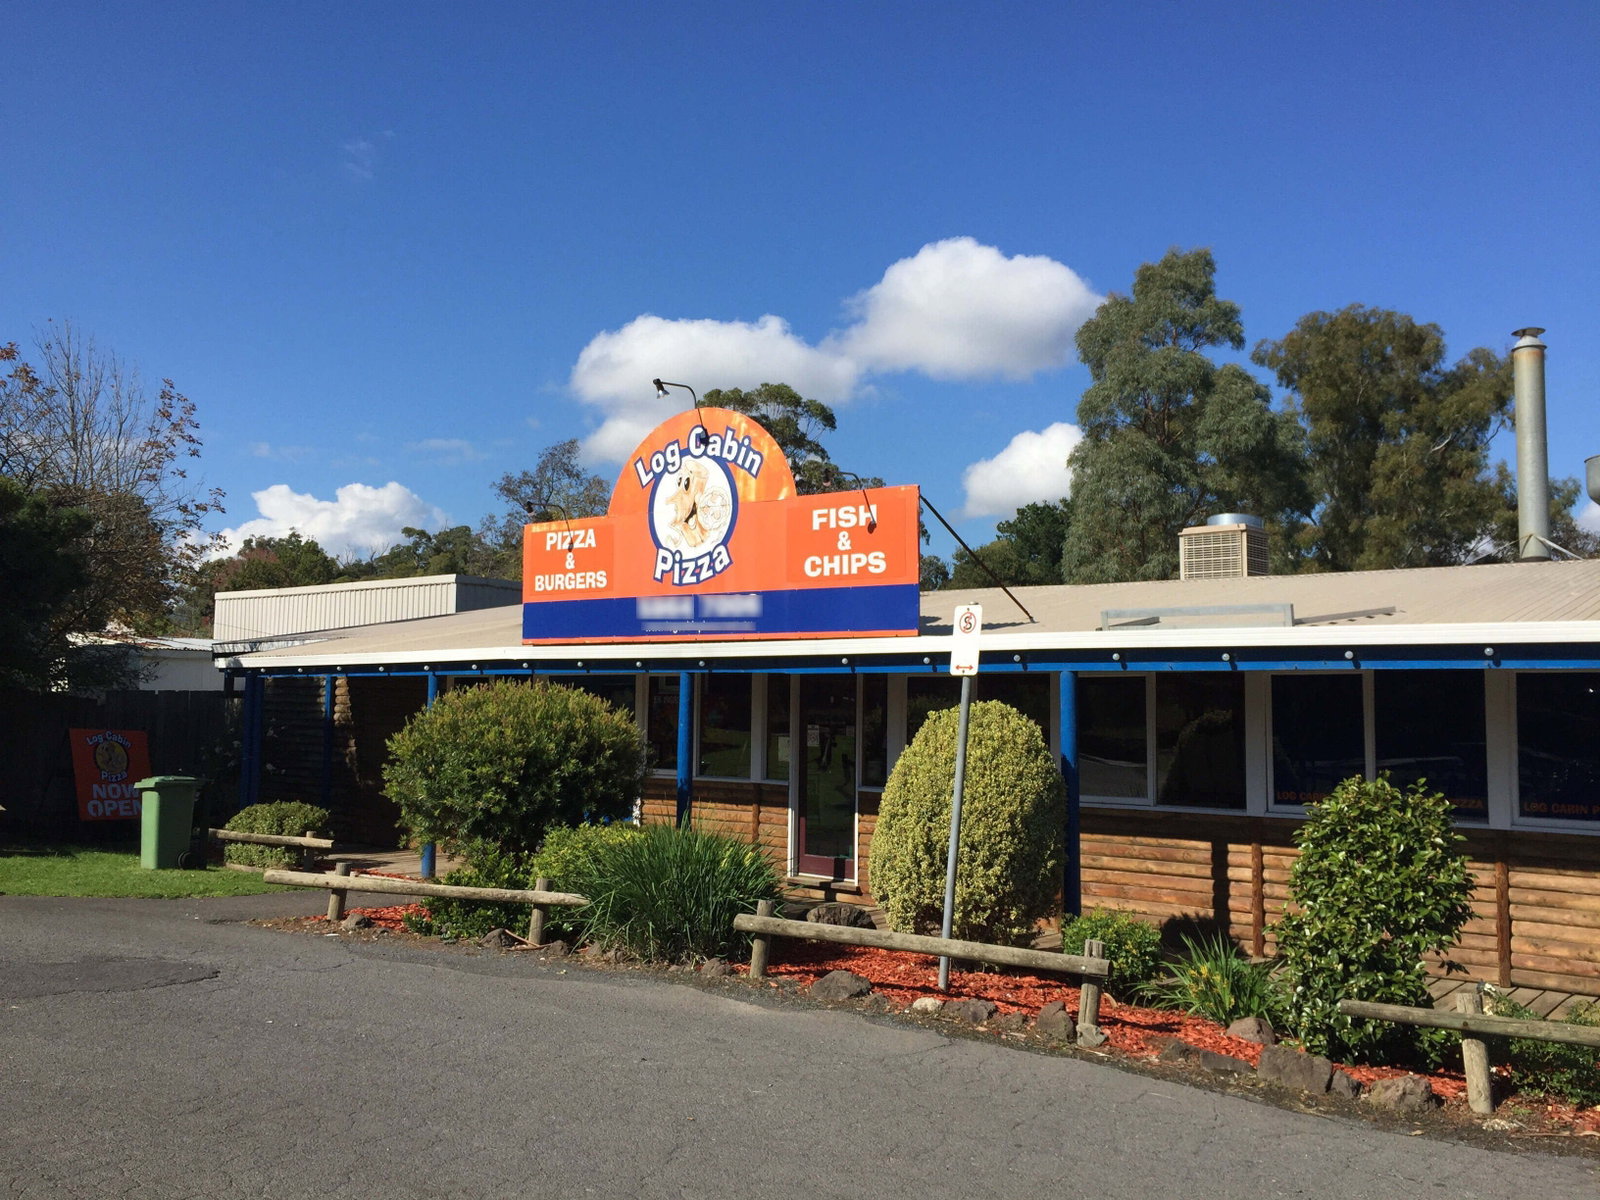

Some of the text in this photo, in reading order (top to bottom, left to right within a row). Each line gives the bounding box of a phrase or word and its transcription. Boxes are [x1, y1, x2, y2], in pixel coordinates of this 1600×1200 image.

[634, 425, 763, 489] Log Cabin
[811, 504, 878, 531] FISH
[545, 528, 597, 551] PIZZA
[837, 531, 852, 551] &
[565, 552, 576, 570] &
[653, 543, 732, 585] Pizza
[803, 551, 887, 577] CHIPS
[534, 570, 608, 592] BURGERS
[86, 731, 132, 748] Log Cabin
[101, 770, 128, 782] Pizza
[92, 783, 140, 799] NOW
